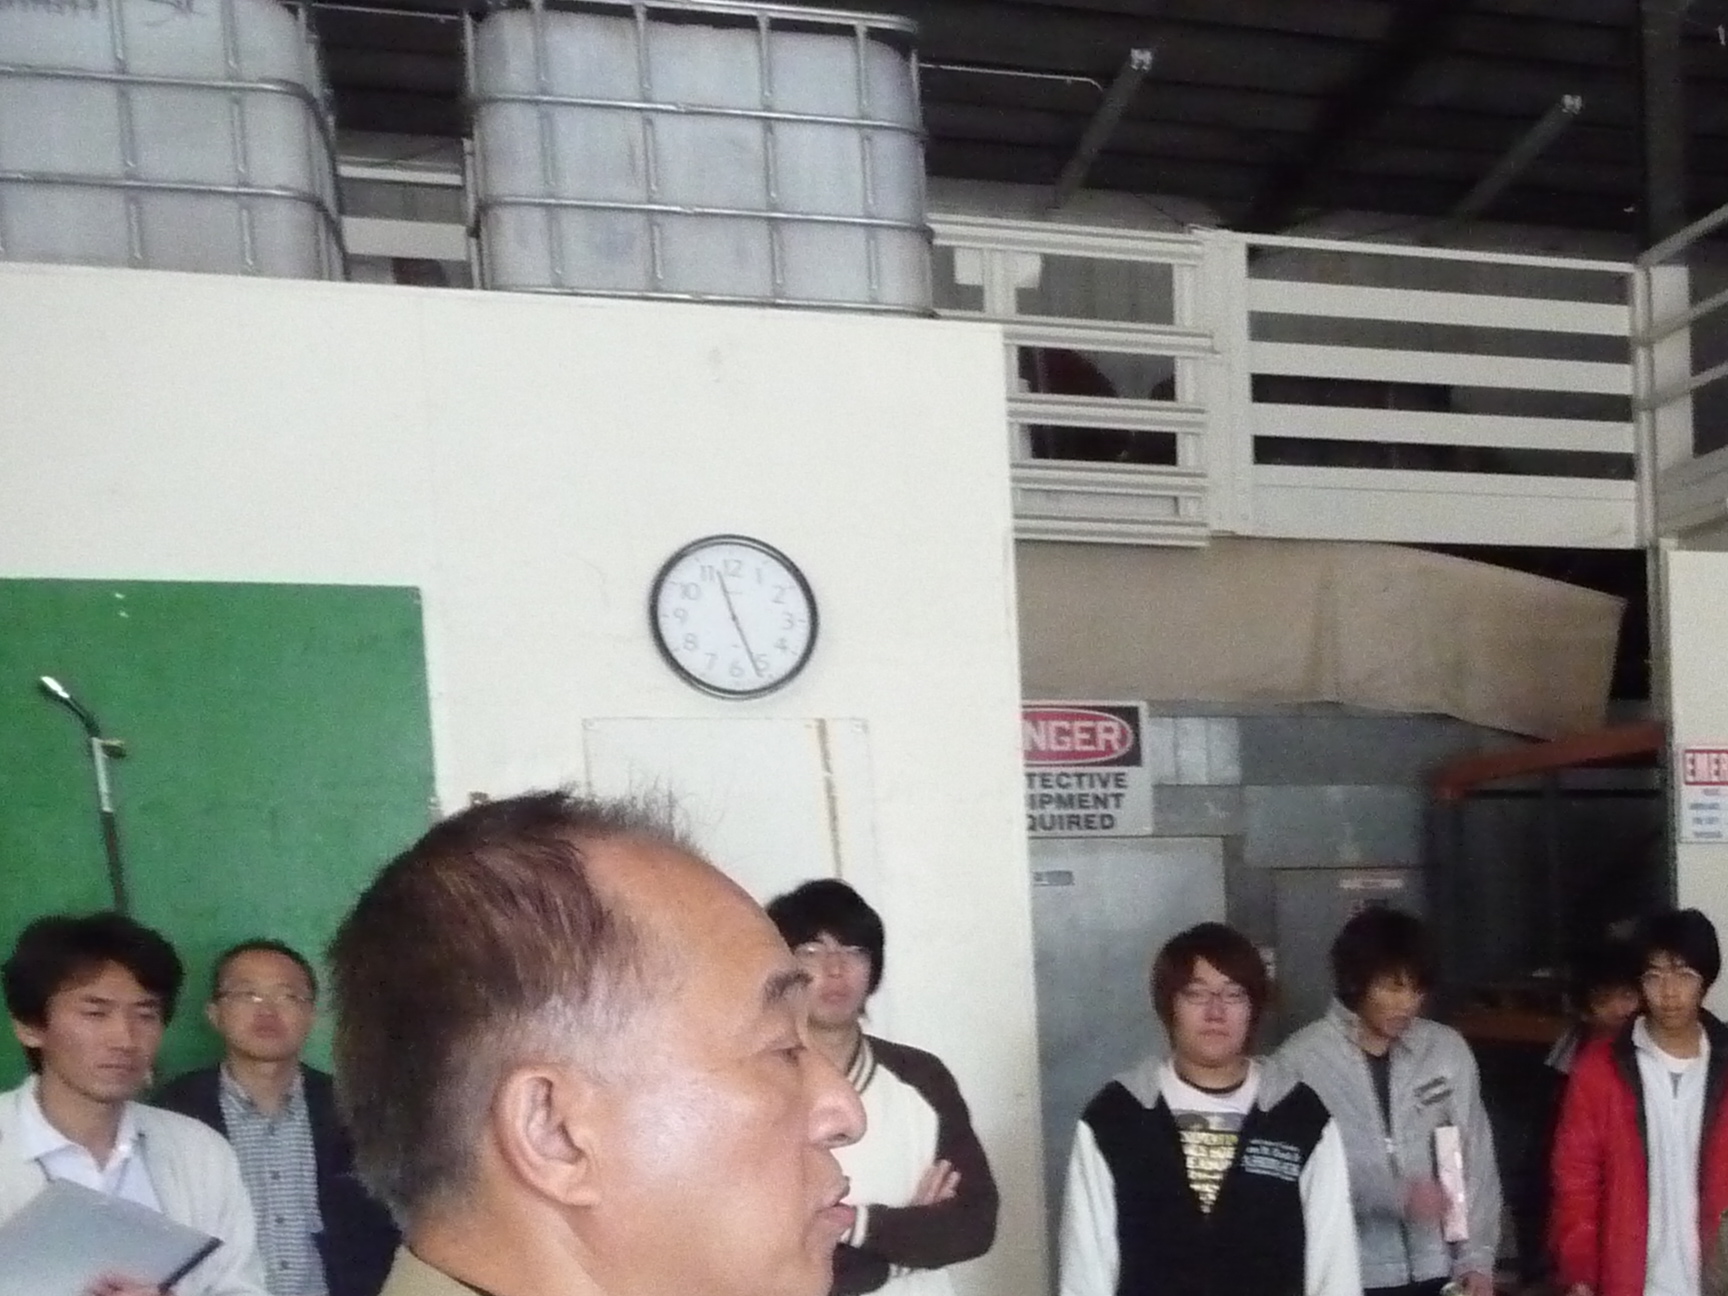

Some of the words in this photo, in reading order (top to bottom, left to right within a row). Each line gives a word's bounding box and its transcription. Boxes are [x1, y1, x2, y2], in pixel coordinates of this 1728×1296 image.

[699, 564, 716, 583] 11
[723, 558, 743, 578] 12
[680, 581, 701, 601] 10
[772, 584, 786, 605] 2
[673, 607, 689, 625] 9
[781, 612, 795, 630] 3
[682, 632, 698, 651] 8
[774, 637, 789, 653] 4
[704, 652, 719, 670] 7
[729, 659, 744, 678] 6
[755, 653, 770, 671] 5
